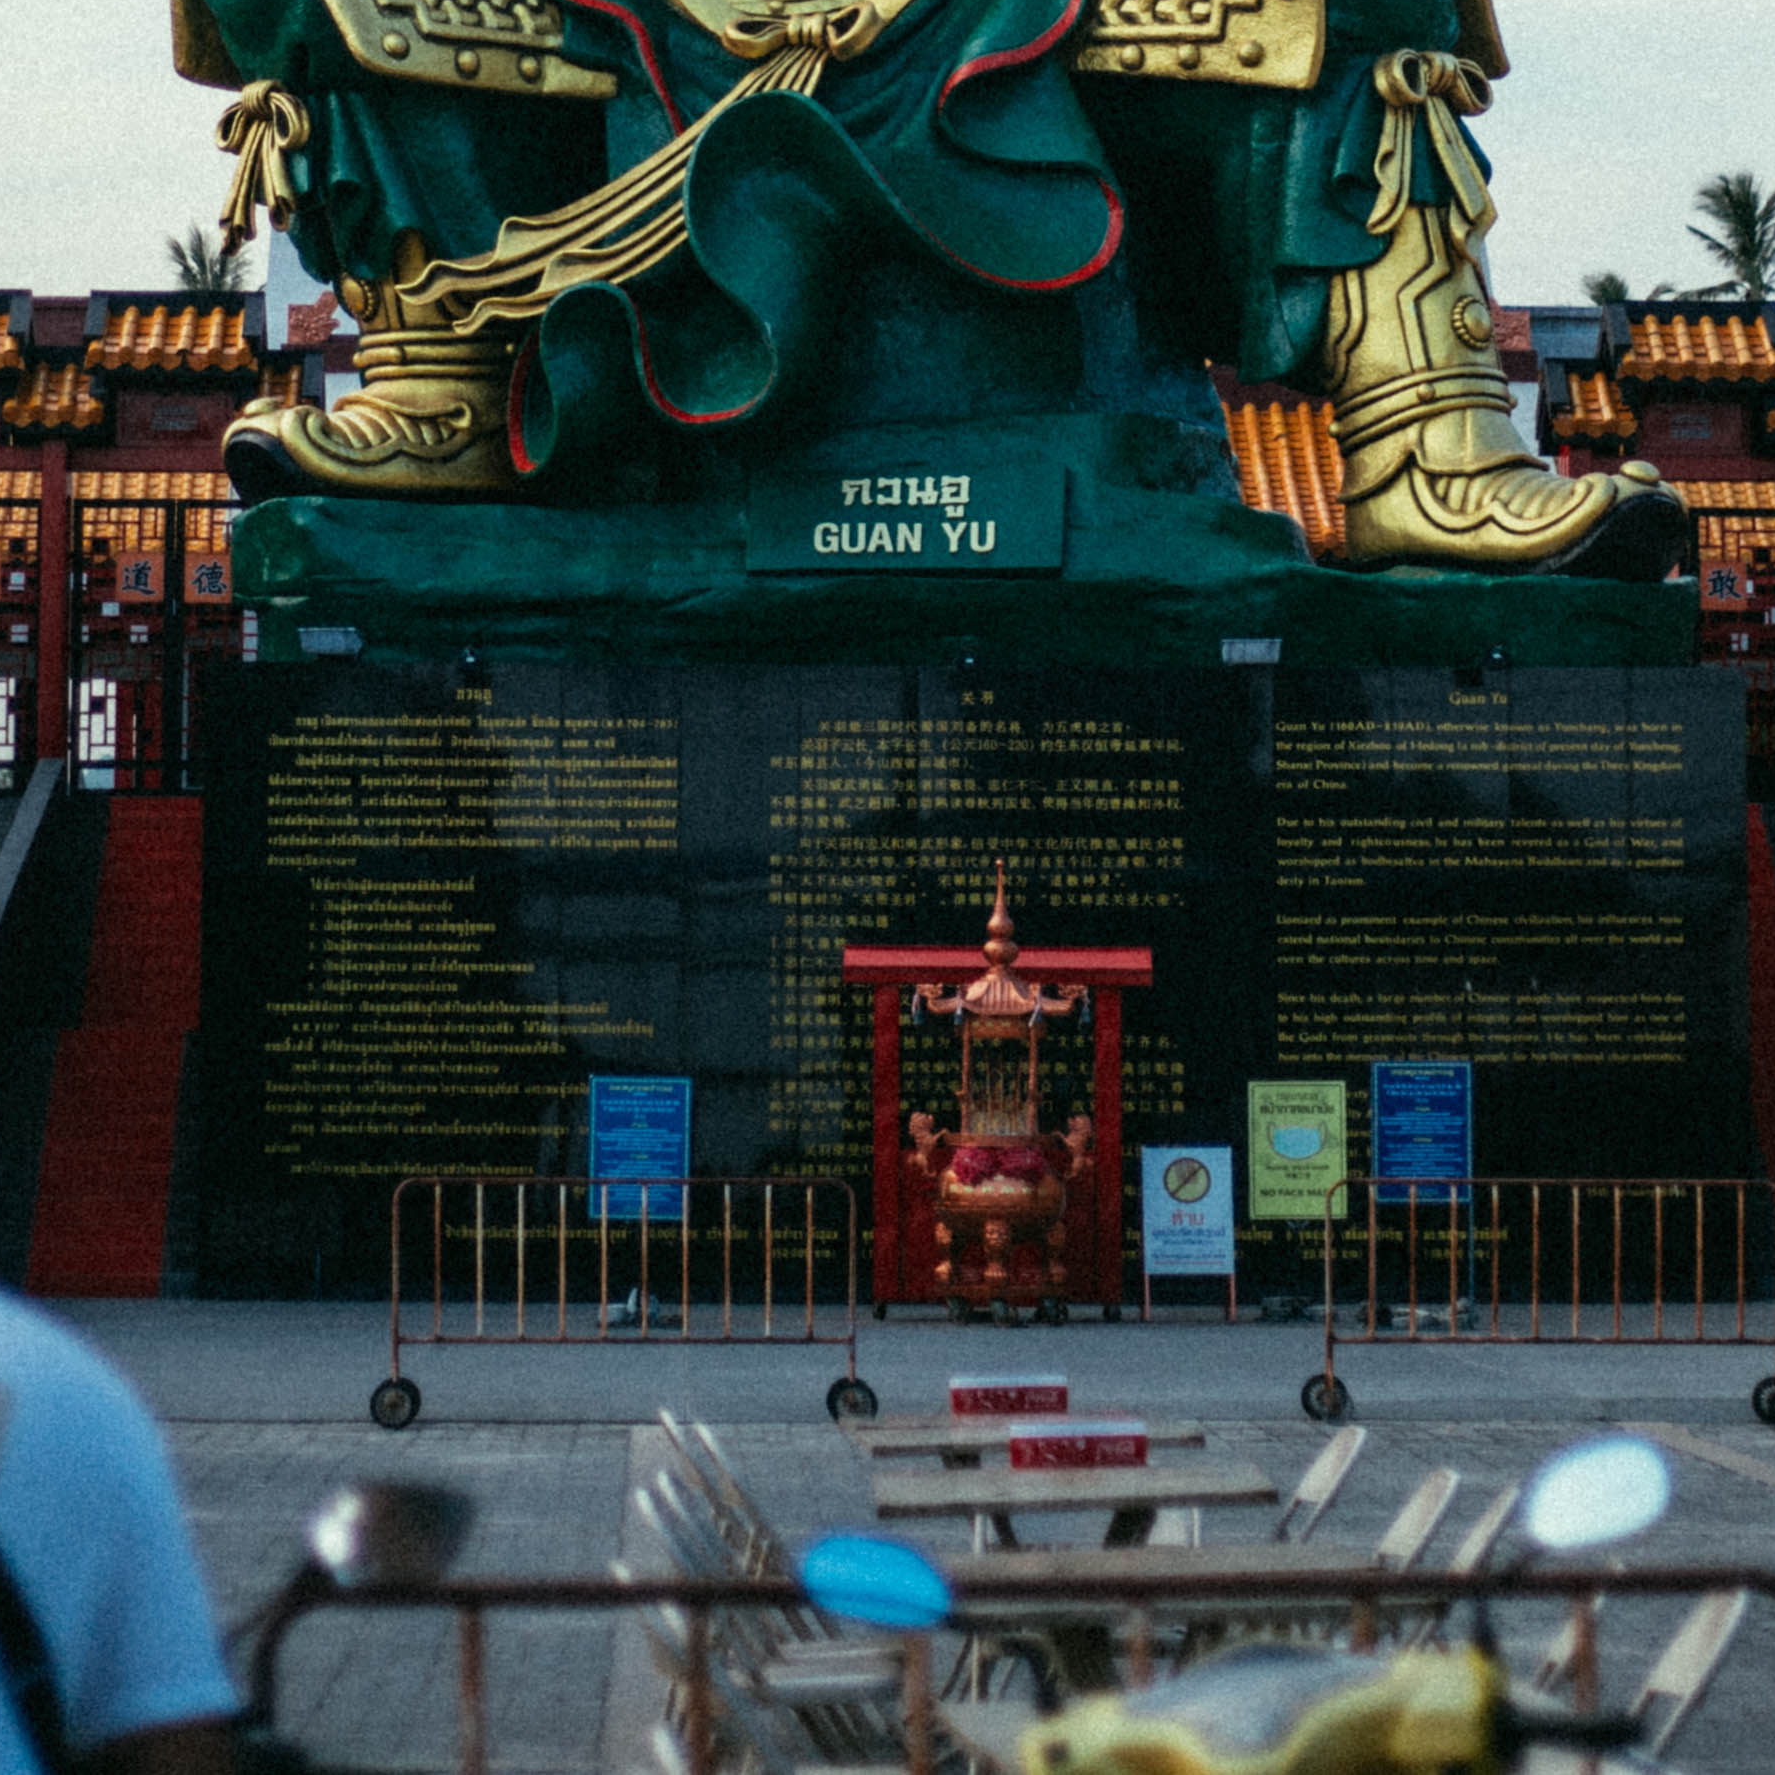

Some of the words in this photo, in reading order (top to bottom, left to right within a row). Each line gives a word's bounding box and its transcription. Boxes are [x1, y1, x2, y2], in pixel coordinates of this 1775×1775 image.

[841, 474, 970, 518] กวนอู
[813, 521, 922, 553] GUAN
[942, 520, 997, 553] YU
[121, 561, 156, 596] 道
[191, 561, 227, 596] 德
[1706, 567, 1743, 600] 敢
[1449, 691, 1486, 705] Guan
[1491, 691, 1507, 705] Yu
[1275, 720, 1308, 732] Guan
[1310, 720, 1326, 732] Yu
